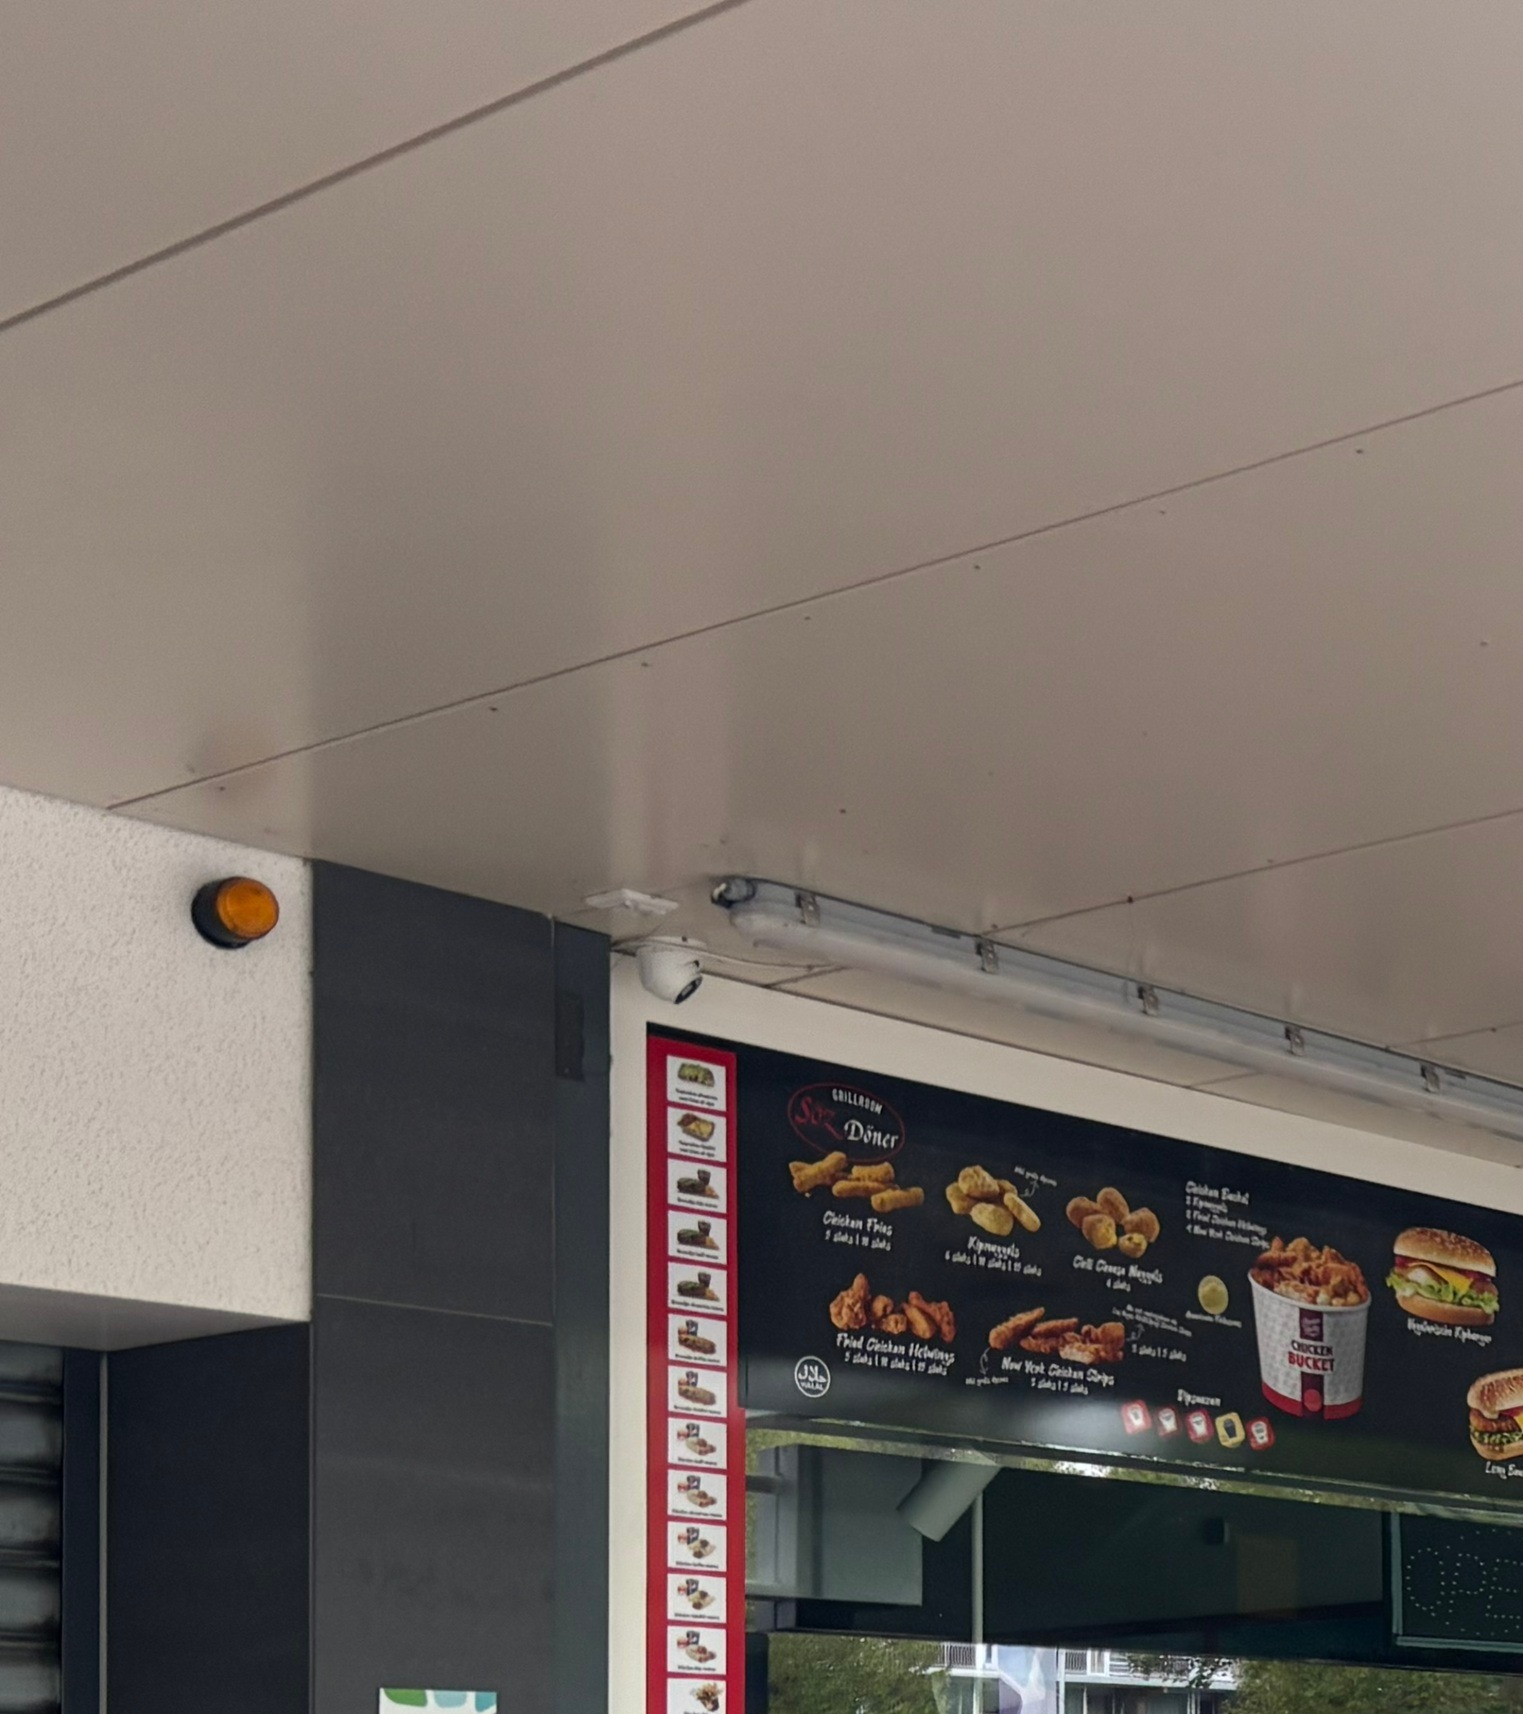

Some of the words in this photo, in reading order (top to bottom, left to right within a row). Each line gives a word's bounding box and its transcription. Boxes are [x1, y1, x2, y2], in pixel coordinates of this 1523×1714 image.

[832, 1088, 883, 1115] GRILLROOM
[844, 1119, 899, 1149] Döner
[822, 1210, 863, 1232] Chicken
[866, 1217, 893, 1237] Fries
[836, 1332, 864, 1350] Fried
[866, 1337, 905, 1355] Chicken
[1290, 1339, 1334, 1357] CHICKEN
[1001, 1355, 1022, 1371] New
[1024, 1358, 1046, 1375] York
[1287, 1351, 1335, 1372] BUCKET
